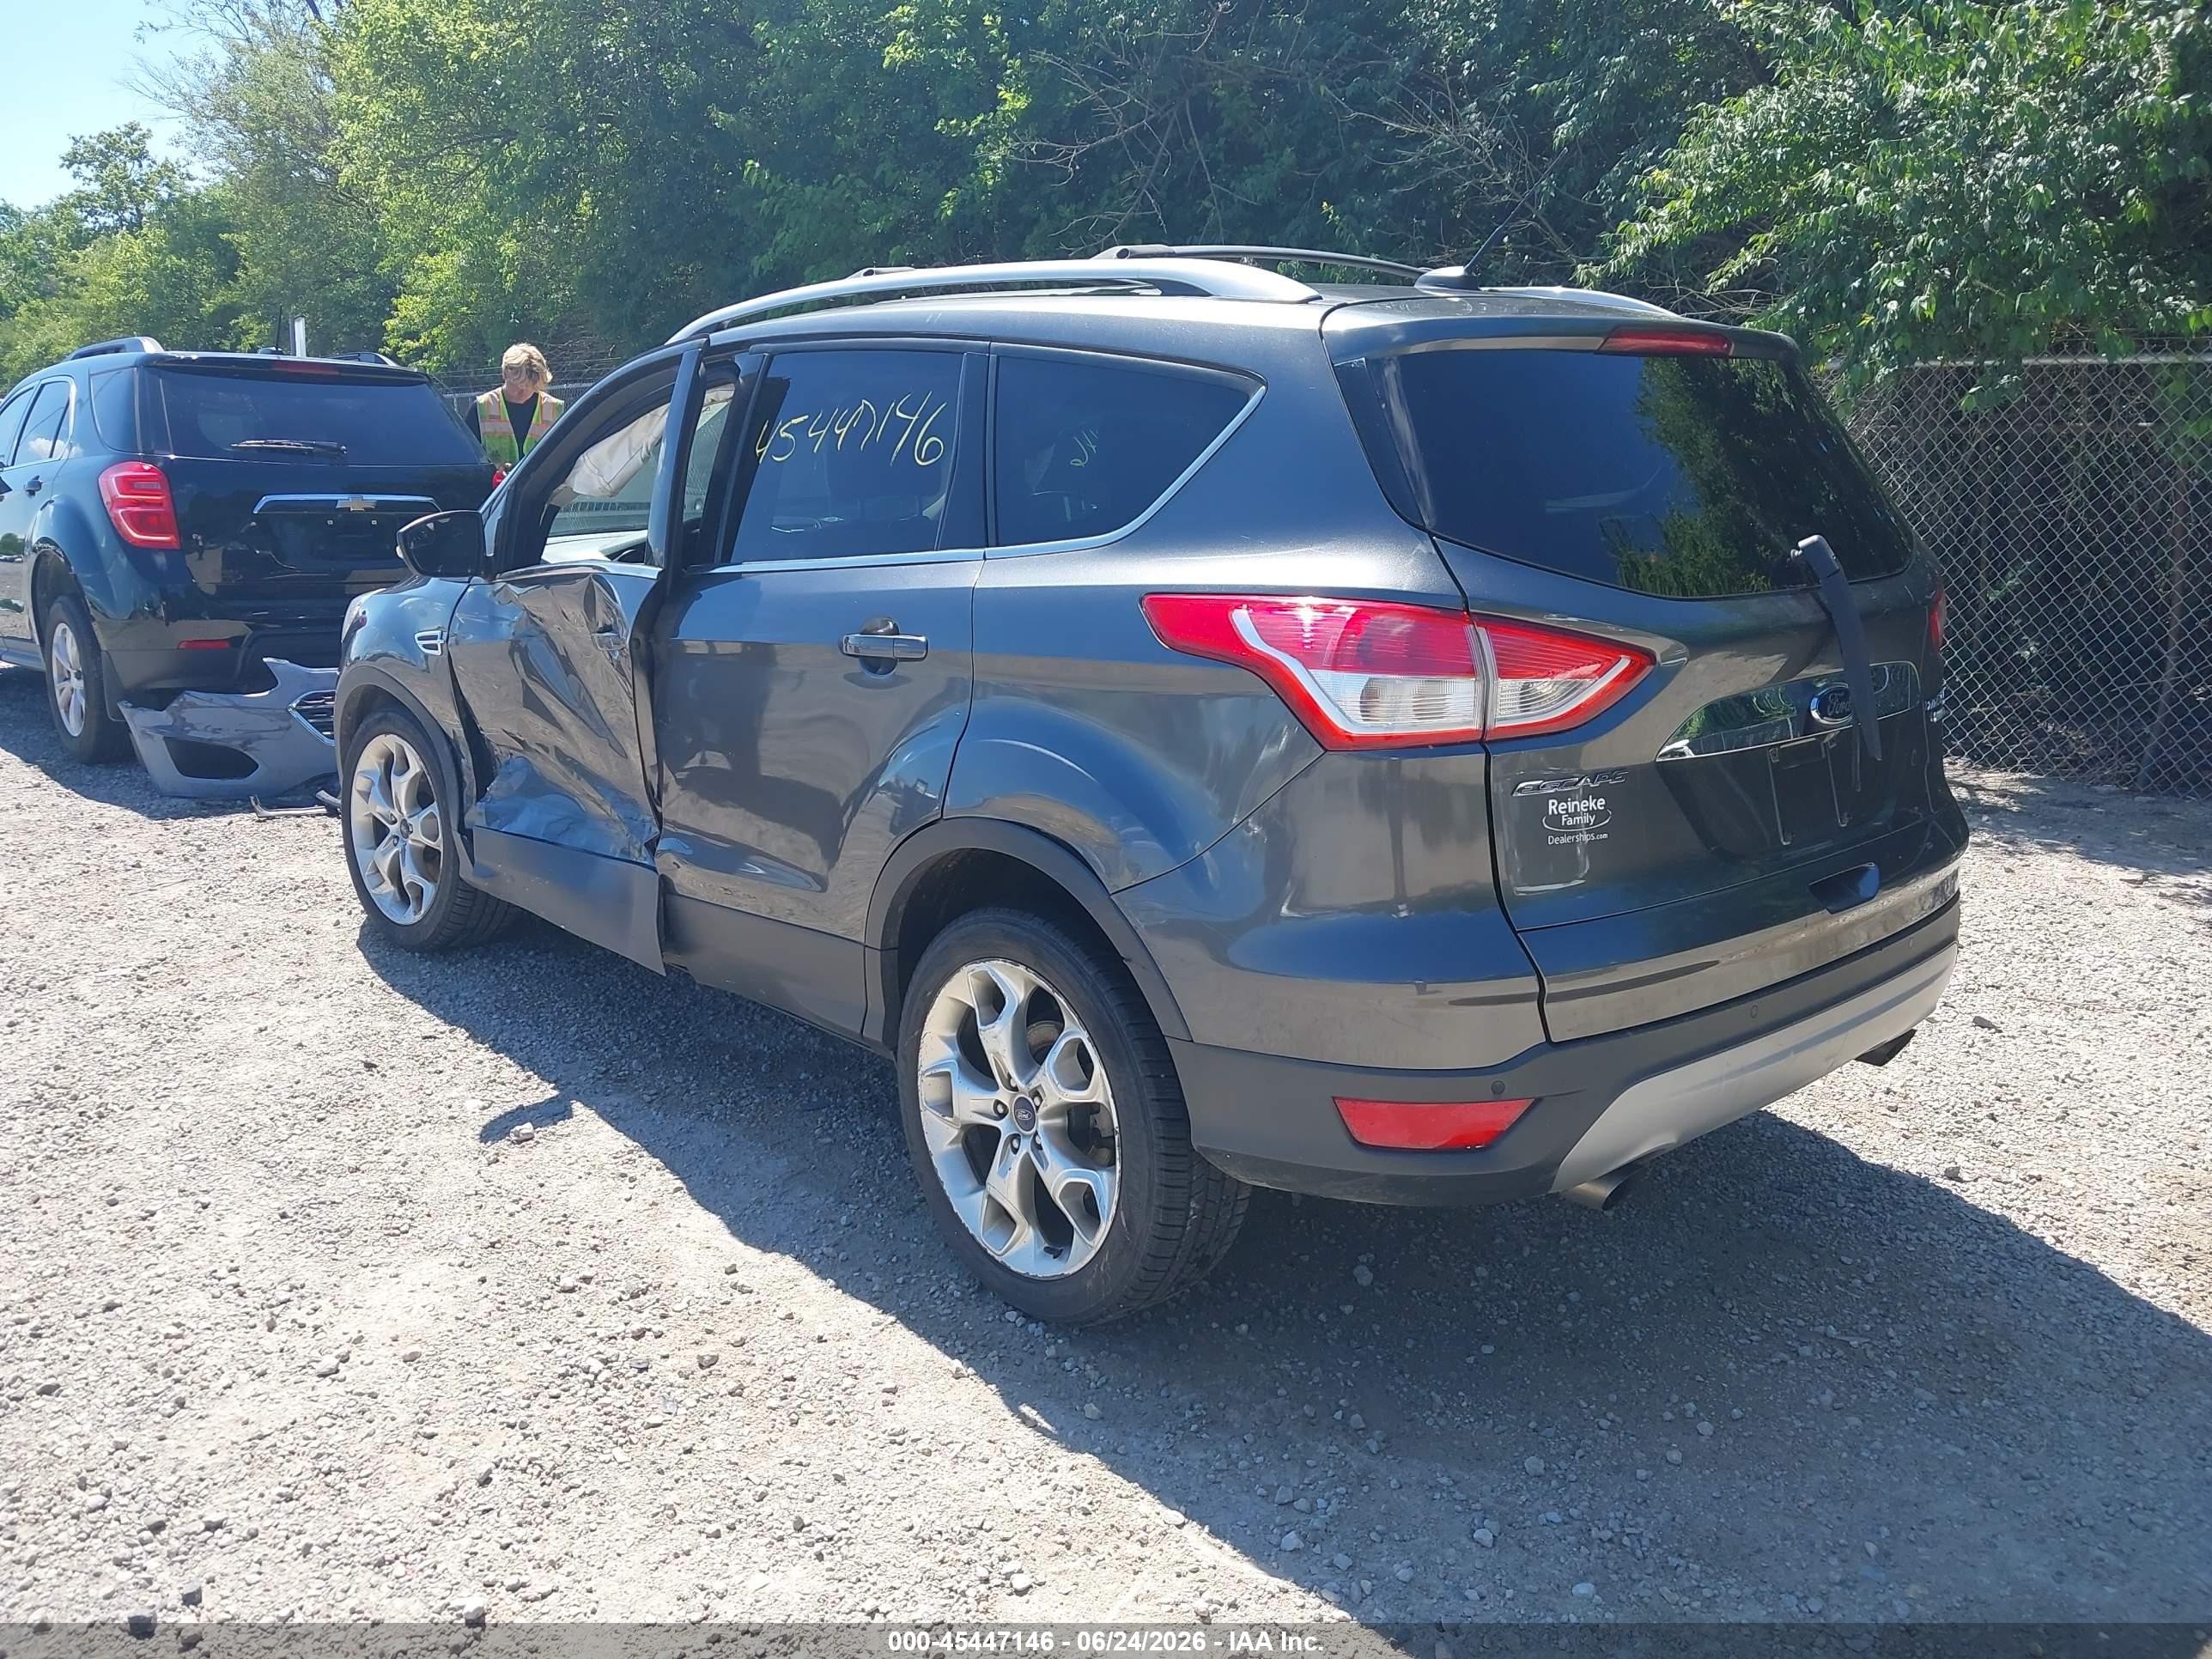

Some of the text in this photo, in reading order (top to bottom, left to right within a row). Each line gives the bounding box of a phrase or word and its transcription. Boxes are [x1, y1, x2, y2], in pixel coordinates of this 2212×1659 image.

[1512, 770, 1629, 797] ESCAPE
[1548, 795, 1607, 816] Reineke
[1561, 812, 1596, 827] Family
[1547, 831, 1609, 846] Dealerships.com
